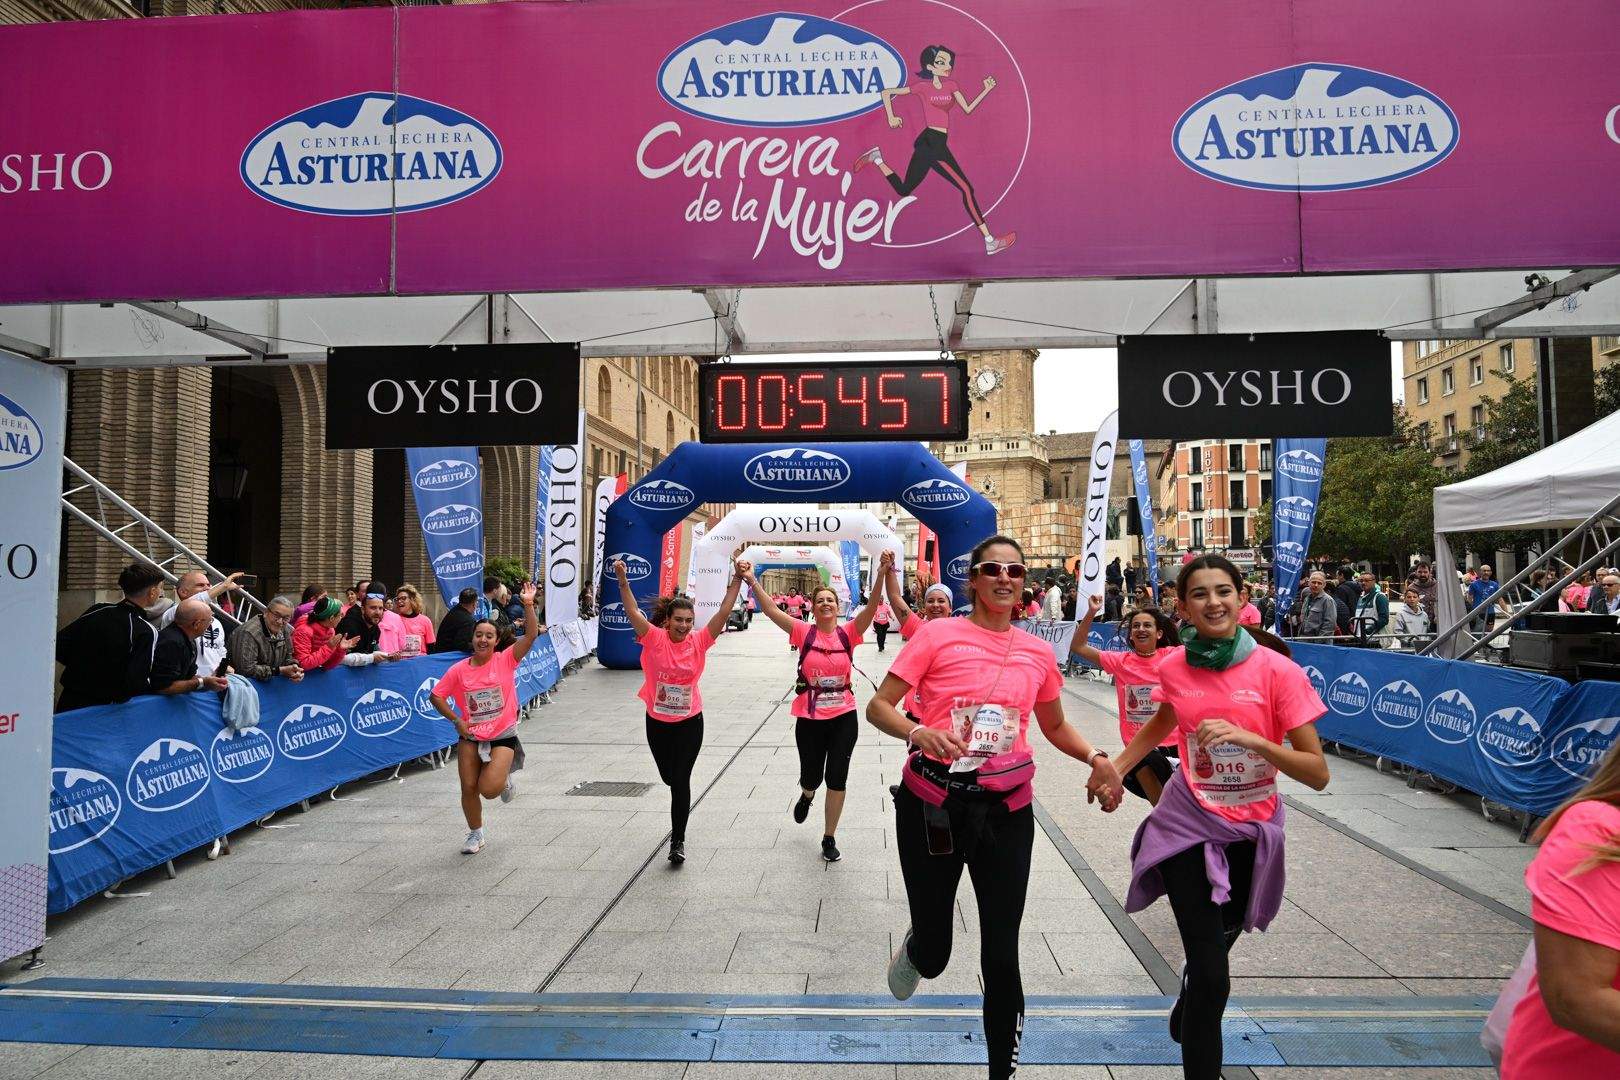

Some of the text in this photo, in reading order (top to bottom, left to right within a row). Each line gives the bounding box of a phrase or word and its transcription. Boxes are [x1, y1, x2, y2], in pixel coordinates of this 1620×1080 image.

[715, 50, 879, 65] CENTRAL LECHERA
[676, 57, 885, 98] ASTURIANA
[1238, 104, 1426, 122] CENTRAL LECHERA
[301, 132, 473, 149] CENTRAL LECHERA
[1195, 113, 1437, 161] ASTURIANA
[260, 141, 482, 186] ASTURIANA
[636, 121, 840, 180] Carrera
[685, 172, 917, 270] de la Mujer
[367, 378, 543, 415] OYSHO
[1162, 368, 1352, 408] OYSHO
[752, 462, 843, 481] ASTURIANA
[1279, 459, 1321, 476] ASTURIAN
[633, 490, 690, 504] ASTURIANA
[908, 491, 966, 503] ASTURIANA
[550, 445, 578, 588] OYSHO
[1084, 440, 1112, 582] OYSHO
[759, 516, 841, 533] OYSHO
[356, 705, 409, 730] ASTURIANA
[1374, 694, 1418, 720] ASTURIANA
[283, 722, 343, 752] ASTURIANA
[974, 730, 999, 742] 016
[216, 743, 272, 773] ASTURIANA
[1216, 762, 1245, 774] 016
[72, 784, 107, 800] LECHERA
[136, 762, 209, 803] ASTURIANA
